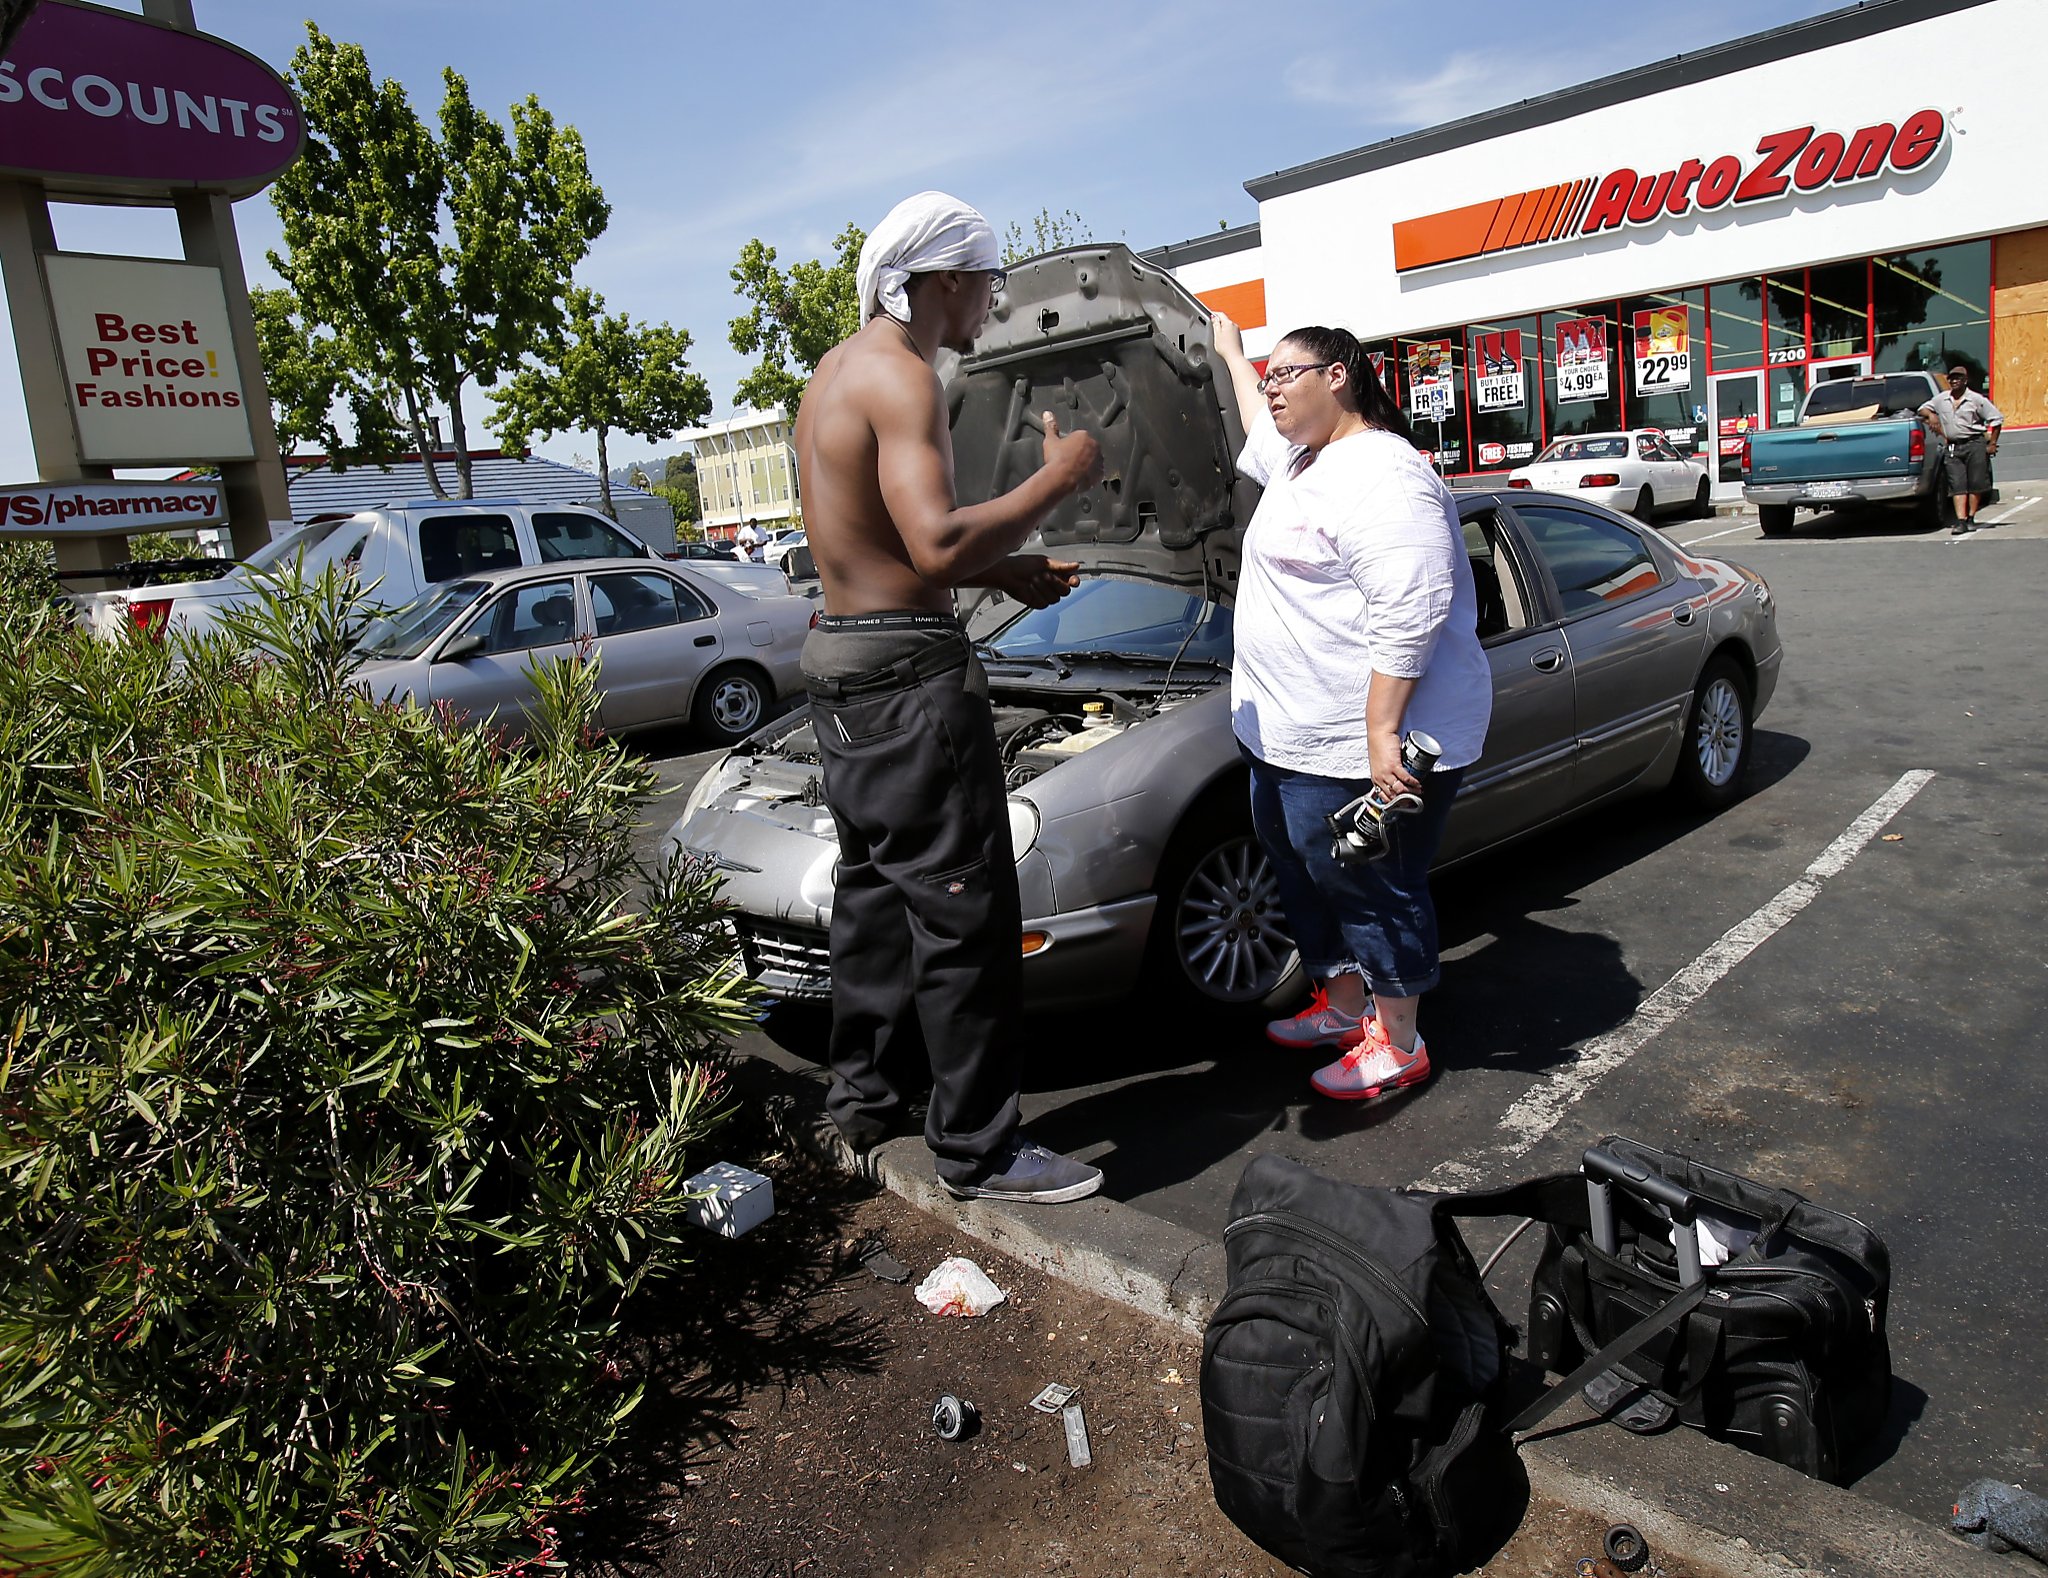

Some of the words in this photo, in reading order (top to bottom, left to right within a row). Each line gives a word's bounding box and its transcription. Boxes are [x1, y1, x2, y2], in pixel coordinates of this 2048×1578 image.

[1581, 108, 1945, 235] AutoZone
[94, 313, 199, 345] Best
[86, 348, 219, 378] Price!
[1768, 348, 1806, 364] 7200
[1564, 367, 1578, 375] YOUR
[1580, 364, 1600, 373] CHOICE
[1481, 379, 1493, 387] BUY
[1501, 375, 1513, 384] GET
[75, 383, 241, 408] Fashions
[1415, 391, 1449, 410] FR!
[1485, 384, 1518, 402] FREE!
[1482, 446, 1502, 460] FREE
[1506, 442, 1534, 453] TESTING
